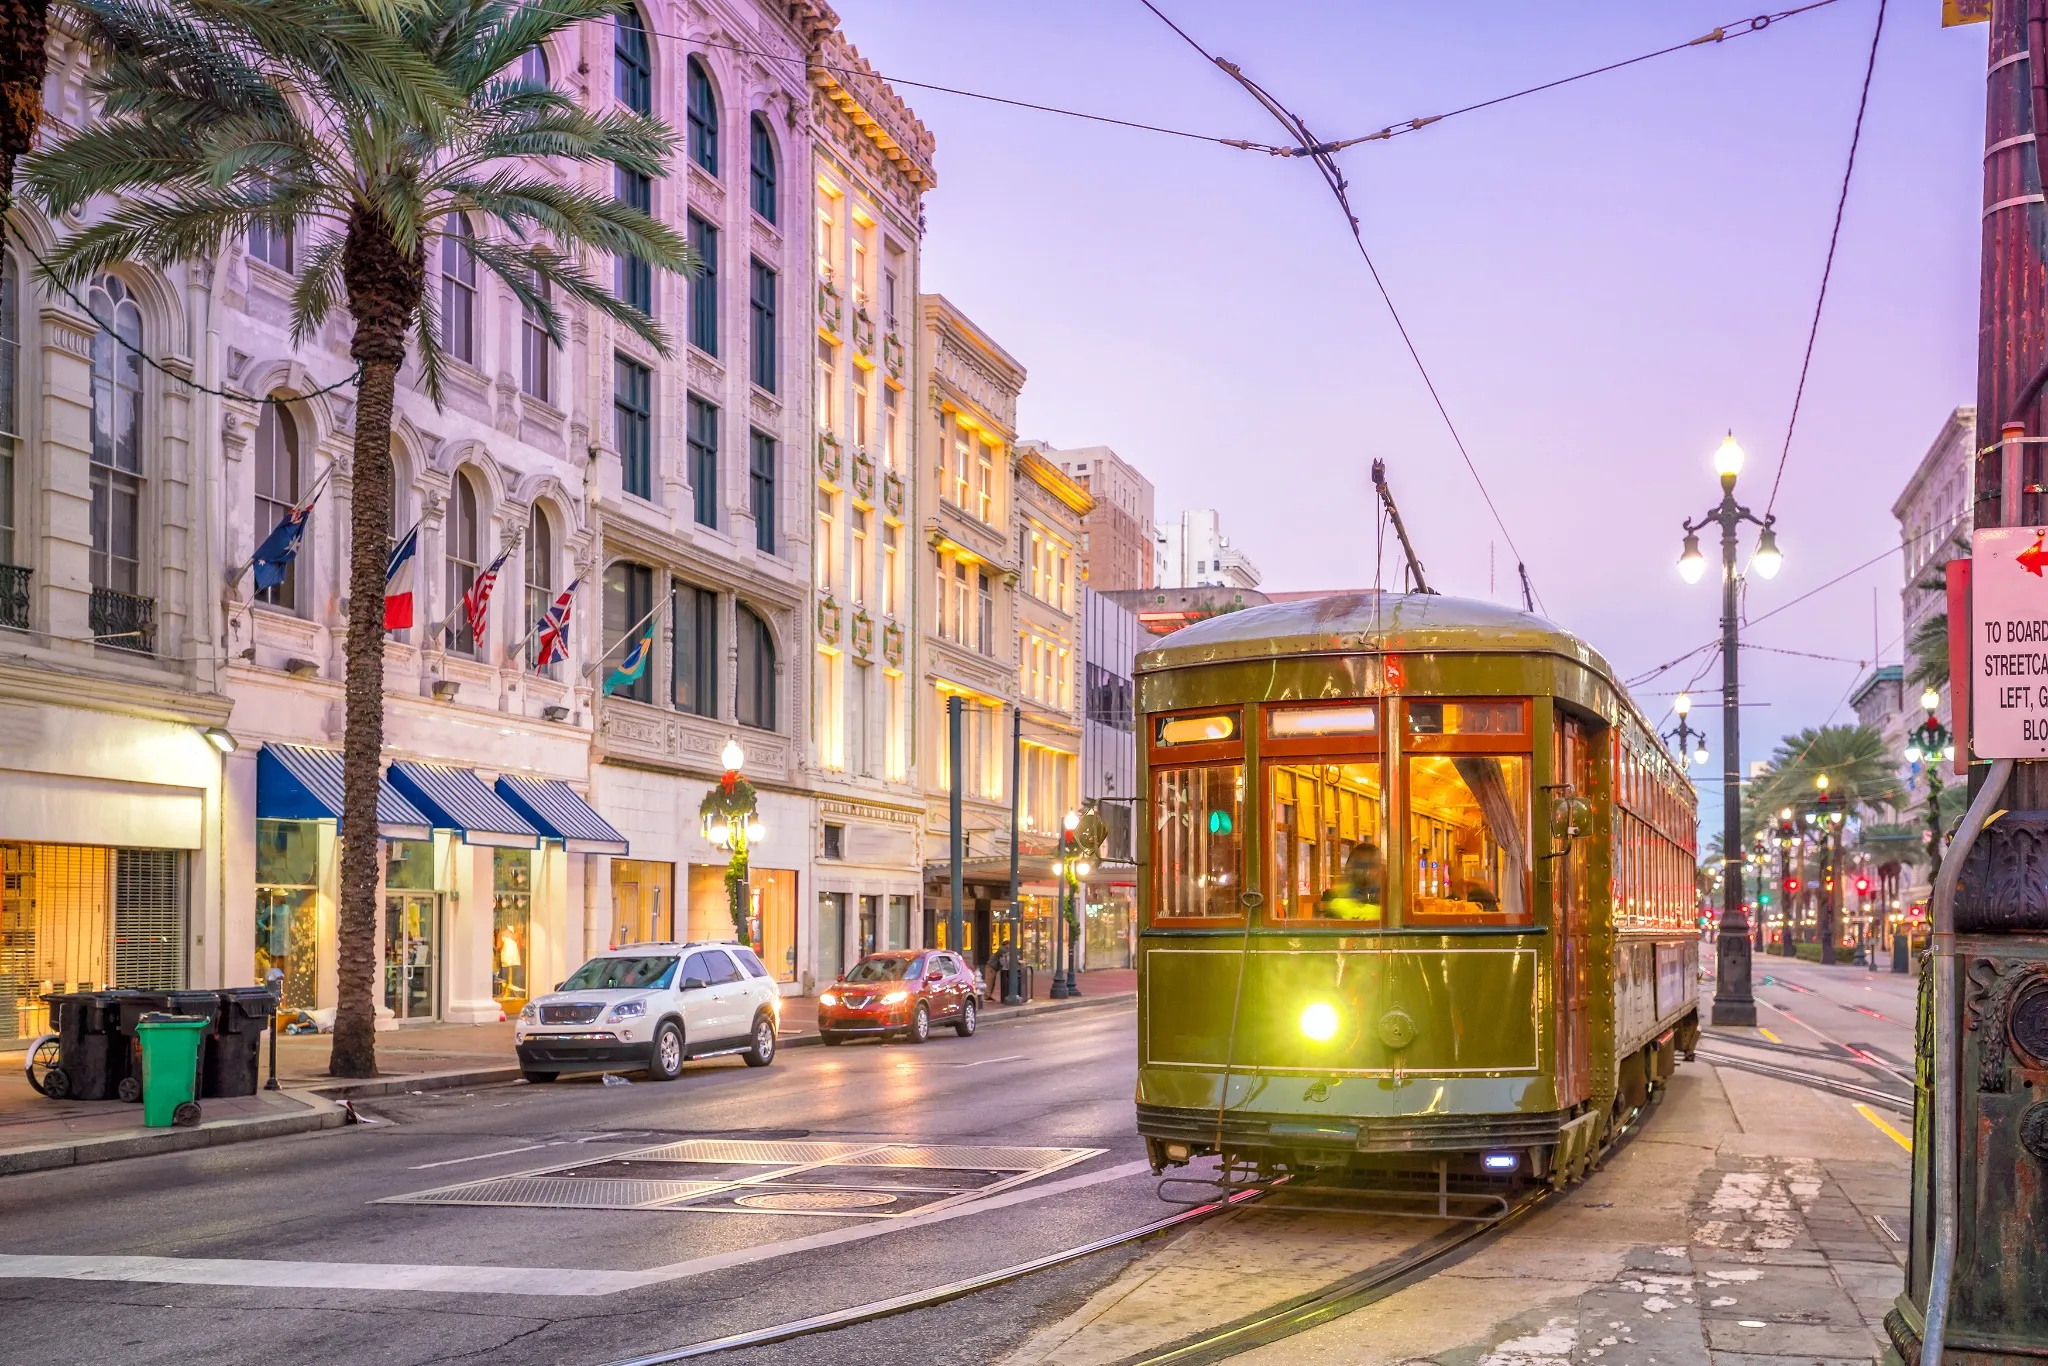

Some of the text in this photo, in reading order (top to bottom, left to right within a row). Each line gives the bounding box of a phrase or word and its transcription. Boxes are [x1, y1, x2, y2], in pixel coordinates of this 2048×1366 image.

[1985, 620, 2048, 643] TO BOARD
[1985, 653, 2048, 677] STREETCA
[2000, 686, 2034, 712] LEFT,
[2023, 718, 2048, 741] BLO
